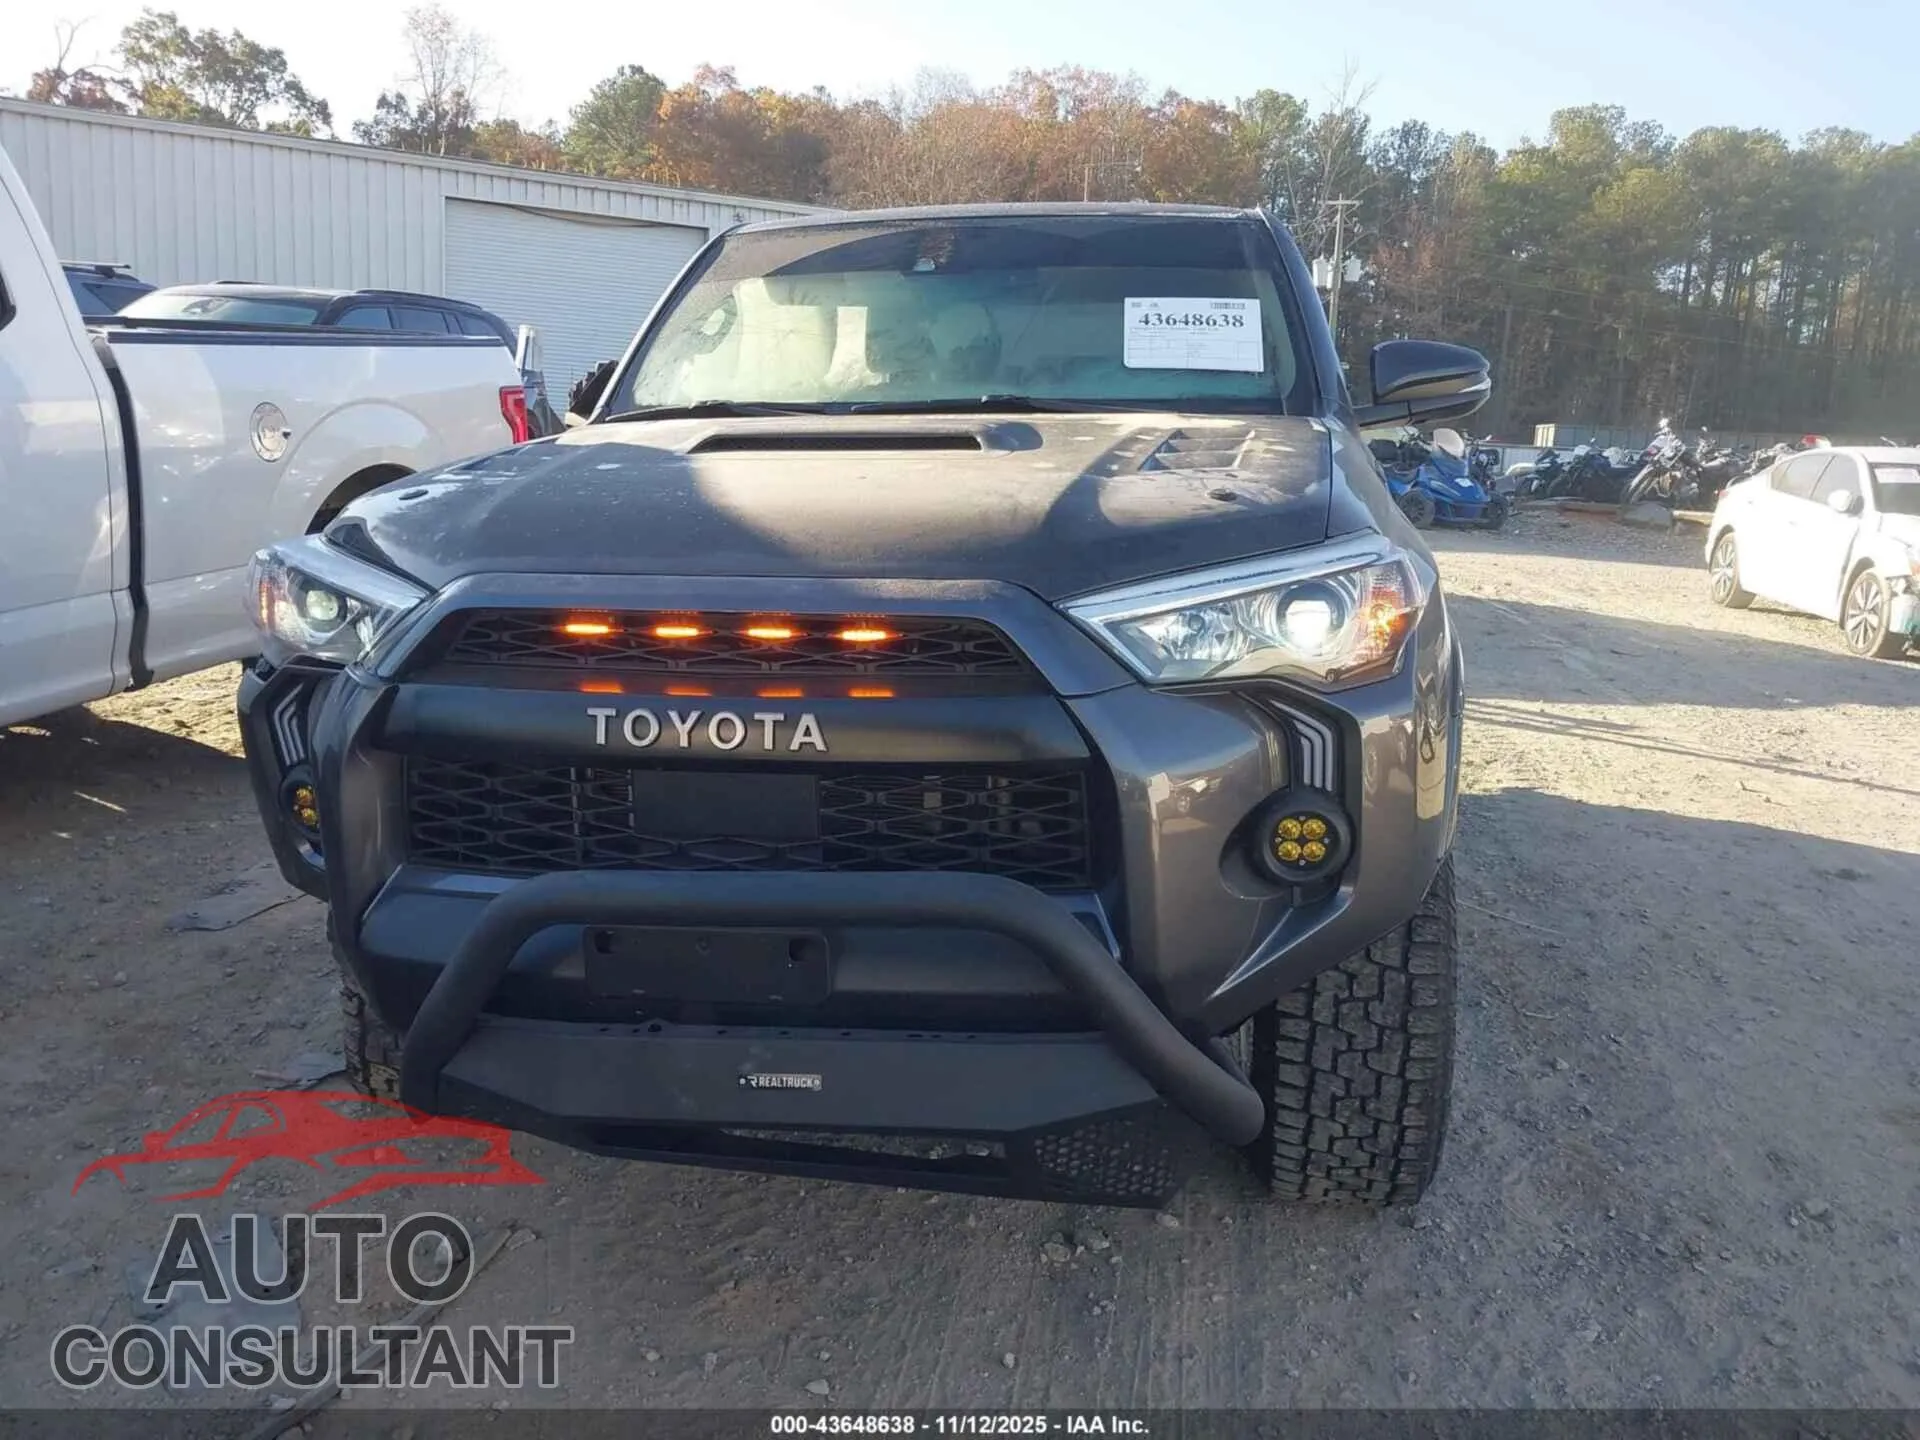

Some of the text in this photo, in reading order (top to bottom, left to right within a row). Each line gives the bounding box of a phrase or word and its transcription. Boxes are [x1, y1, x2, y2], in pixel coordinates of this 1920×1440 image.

[1138, 312, 1245, 328] 43648638
[586, 707, 828, 752] TOYOTA
[758, 1076, 814, 1088] REALTRUCK
